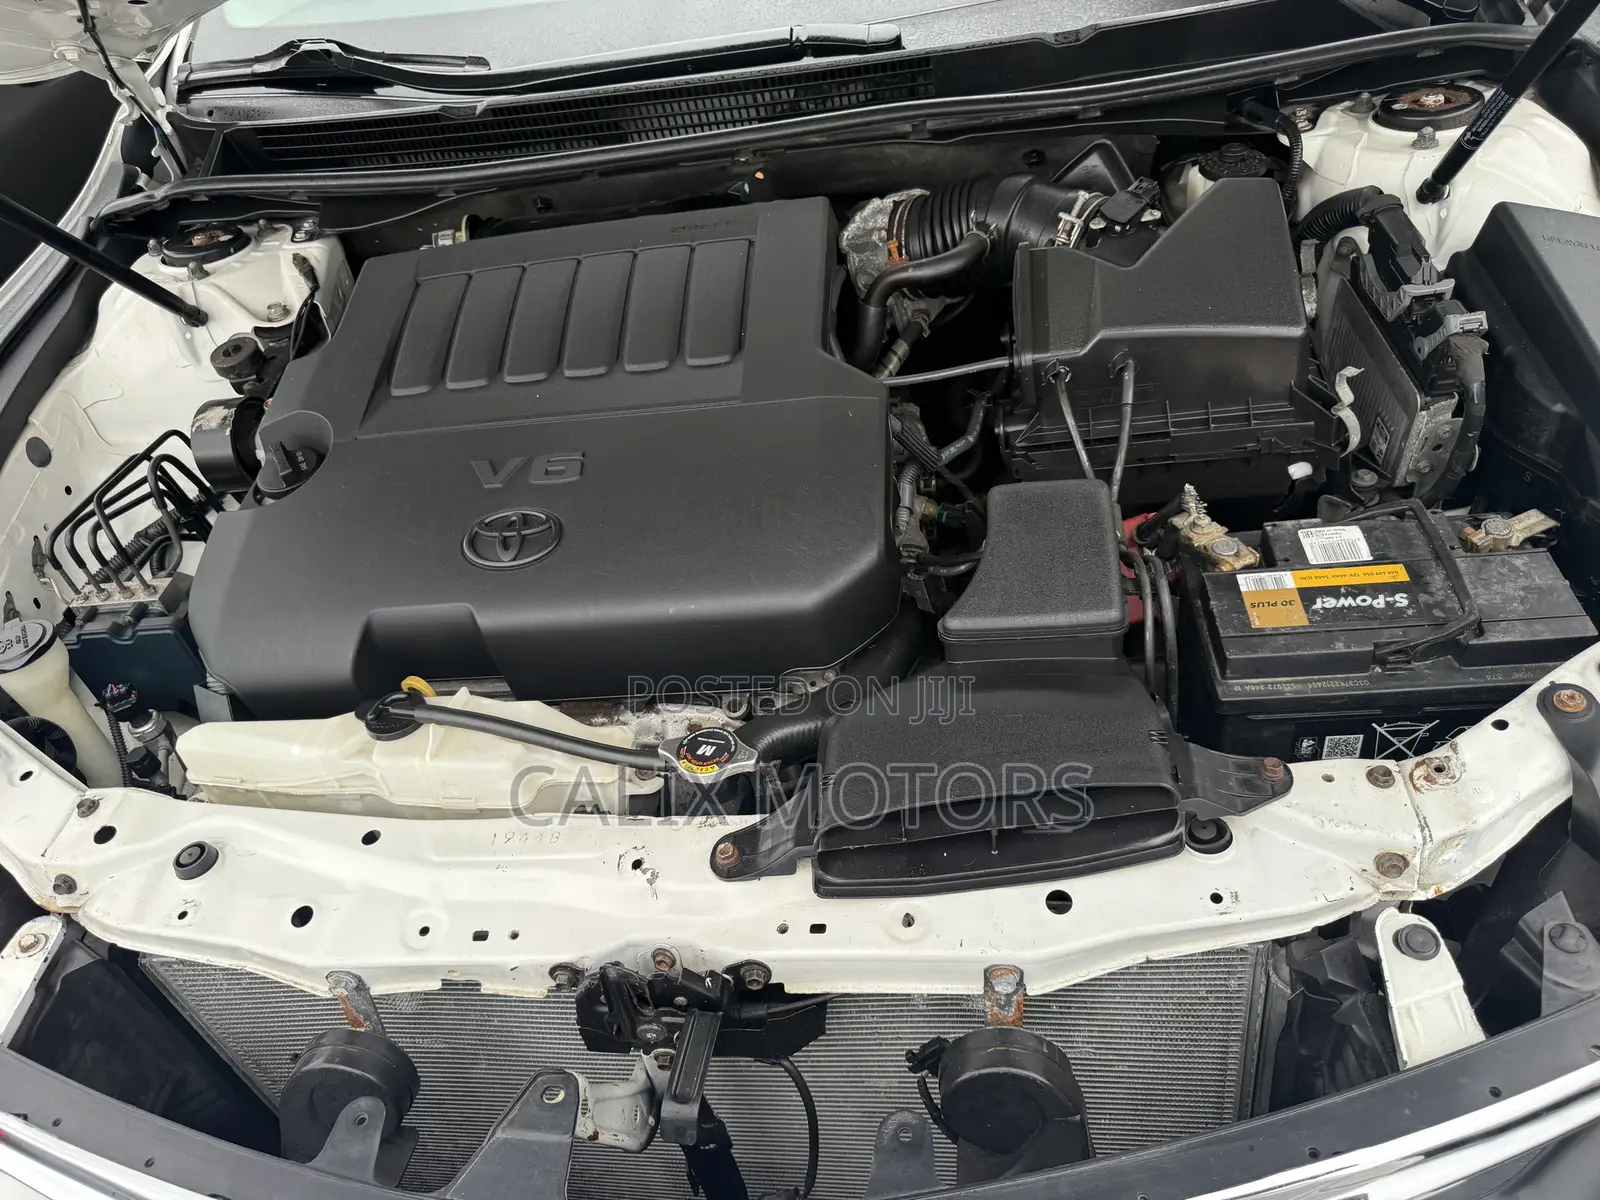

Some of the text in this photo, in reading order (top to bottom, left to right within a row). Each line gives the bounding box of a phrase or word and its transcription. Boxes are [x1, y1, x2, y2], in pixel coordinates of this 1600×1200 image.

[470, 451, 586, 488] V6
[1250, 599, 1296, 610] 30 PLUS
[1314, 592, 1409, 610] S-Power
[696, 744, 717, 756] M
